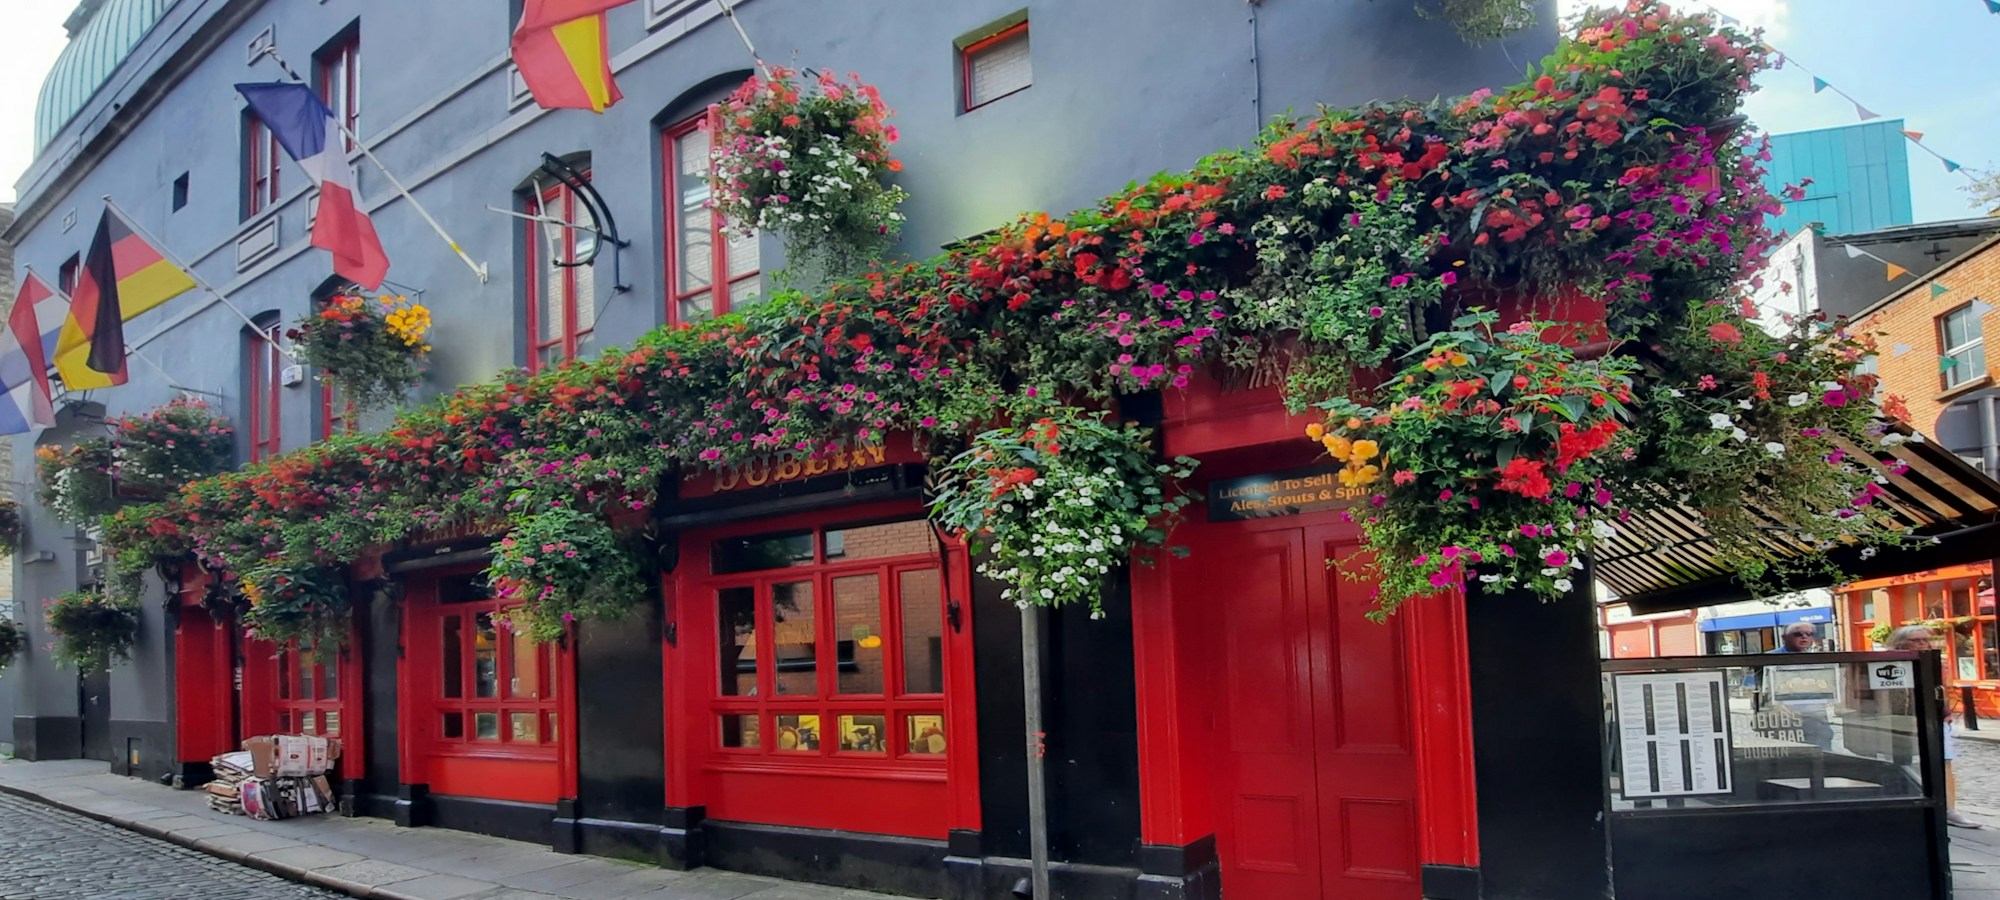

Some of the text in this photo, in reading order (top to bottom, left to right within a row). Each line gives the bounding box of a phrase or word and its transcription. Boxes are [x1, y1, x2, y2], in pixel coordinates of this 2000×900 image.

[712, 439, 888, 492] DUBLIN
[1219, 480, 1280, 499] Licensed
[1282, 478, 1300, 490] To
[1304, 473, 1332, 487] Sell
[1268, 493, 1315, 507] Stouts
[1319, 489, 1332, 501] &
[1778, 729, 1805, 743] BAR
[1743, 746, 1790, 759] DUBLIN
